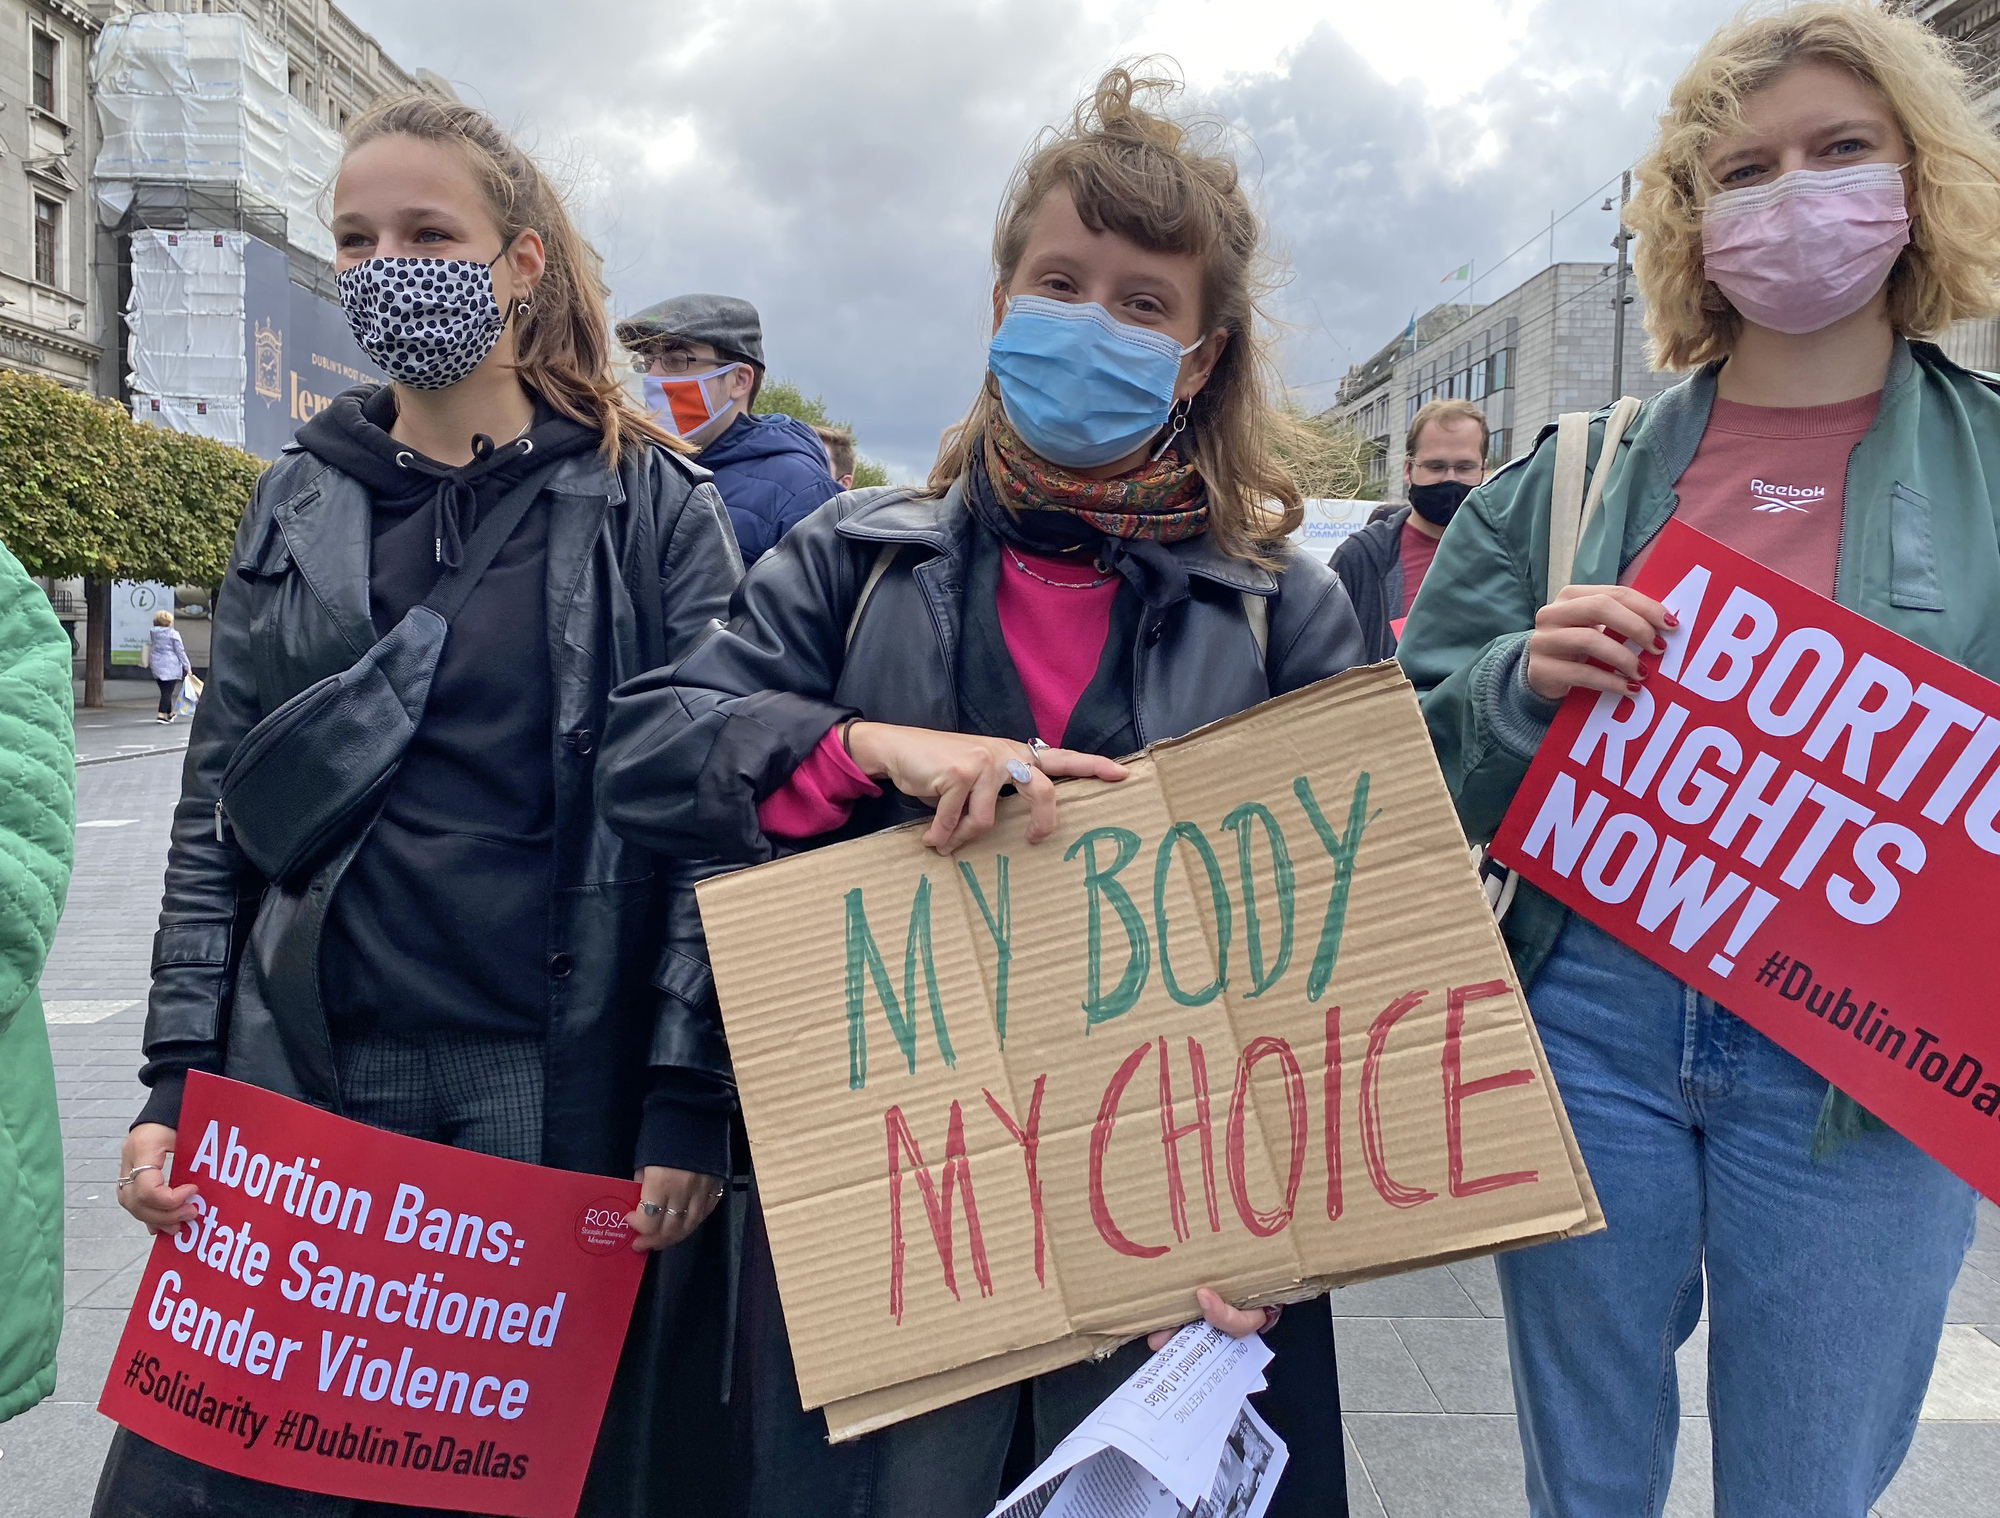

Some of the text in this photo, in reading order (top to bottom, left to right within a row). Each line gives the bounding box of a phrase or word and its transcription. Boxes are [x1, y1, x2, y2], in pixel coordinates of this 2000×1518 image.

[311, 352, 342, 375] DUBLIN'S
[1750, 479, 1825, 497] Reebok
[1568, 669, 1927, 925] RIGHTS
[1520, 770, 1781, 979] NOW!
[844, 770, 1383, 1090] MY BODY
[1755, 950, 2000, 1125] #DublinToDa
[190, 1120, 525, 1267] Abortion Bans:
[885, 979, 1539, 1326] MY CHOICE
[174, 1194, 566, 1348] State Sanctioned
[585, 1208, 628, 1228] ROSA
[148, 1270, 530, 1420] Gender Violence
[1133, 1374, 1155, 1389] the
[1144, 1379, 1178, 1407] Dallas
[1167, 1370, 1186, 1382] in
[1172, 1335, 1190, 1349] out
[1174, 1342, 1249, 1424] ONLINE PUBLIC MEETING
[1178, 1340, 1213, 1377] feminist
[123, 1349, 530, 1480] #Solidarity #DublinToDallas
